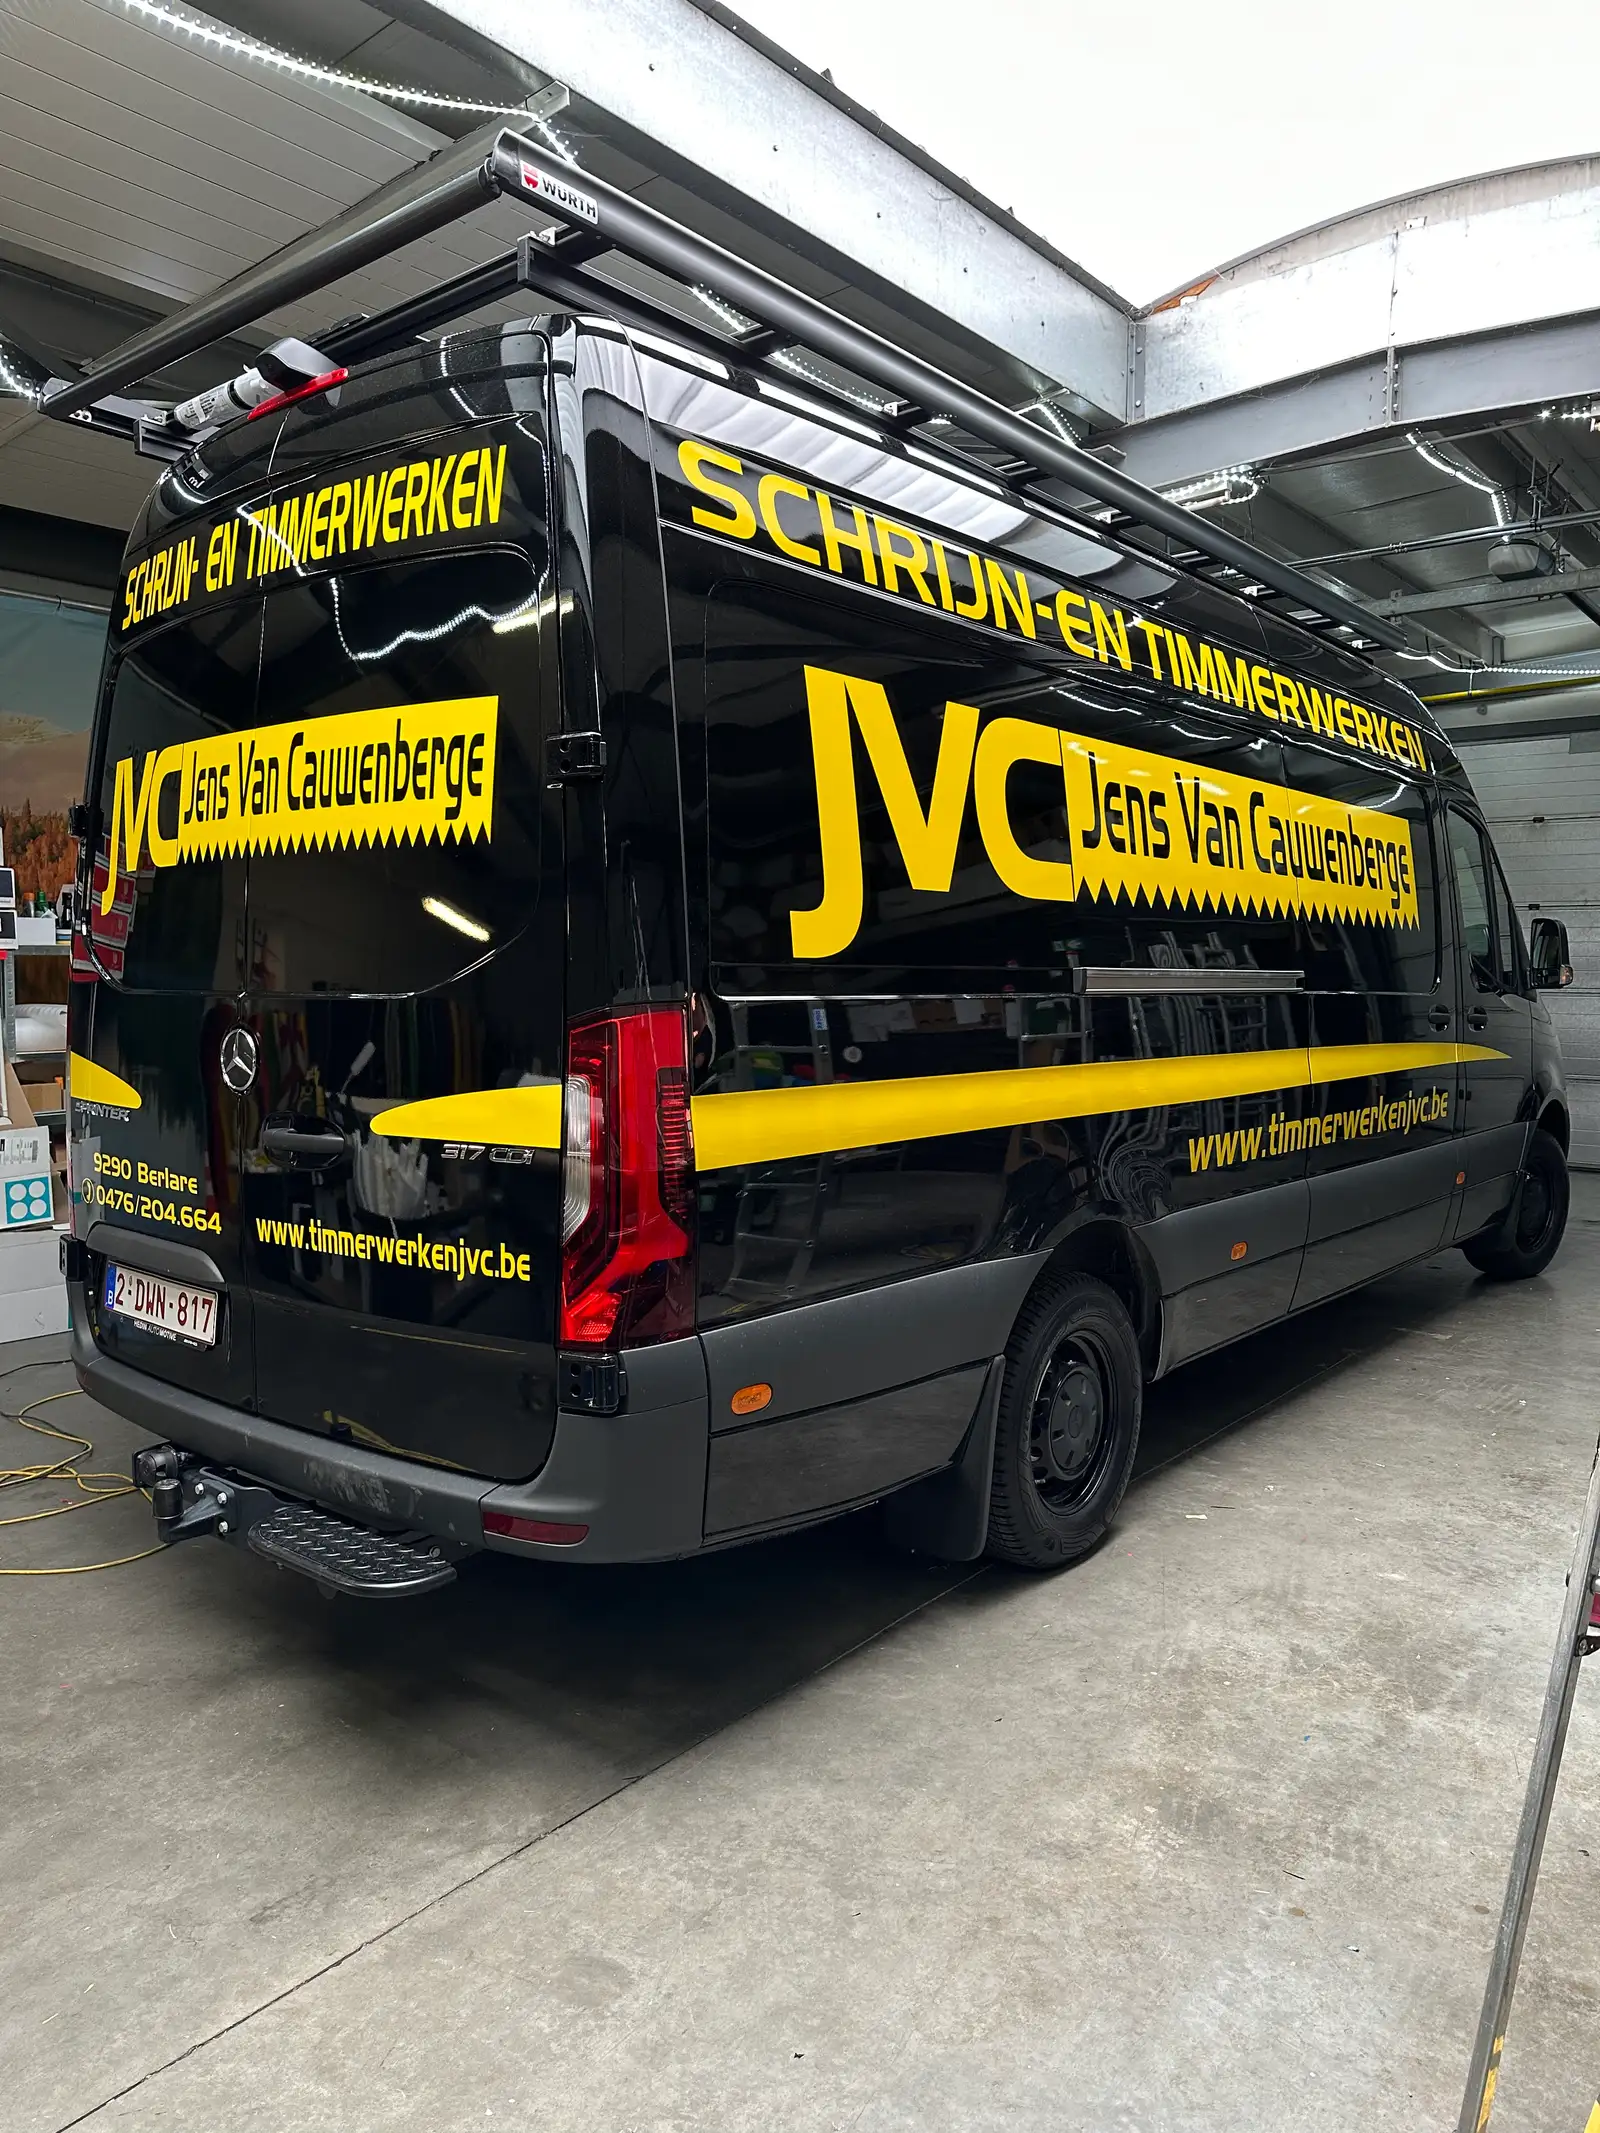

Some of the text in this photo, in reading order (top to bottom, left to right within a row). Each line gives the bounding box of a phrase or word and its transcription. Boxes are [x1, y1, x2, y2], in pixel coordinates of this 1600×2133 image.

[542, 177, 597, 218] WÜRTH
[205, 517, 240, 592] EN
[246, 445, 508, 580] TIMMERWERKEN
[1136, 620, 1427, 772] TIMMERWERKEN
[101, 718, 485, 916] JVC Jens Van Cauwenberge
[790, 665, 1412, 959] JVC Jens Van Cauwenberge
[74, 1101, 131, 1122] SPRINTER
[1188, 1085, 1449, 1174] www.timmerwerkenjvc.be
[93, 1151, 199, 1196] 9290 Berlare
[440, 1143, 486, 1161] 317
[96, 1184, 223, 1236] 0476/204.664
[256, 1216, 531, 1282] www.timmerwerkenjvc.be
